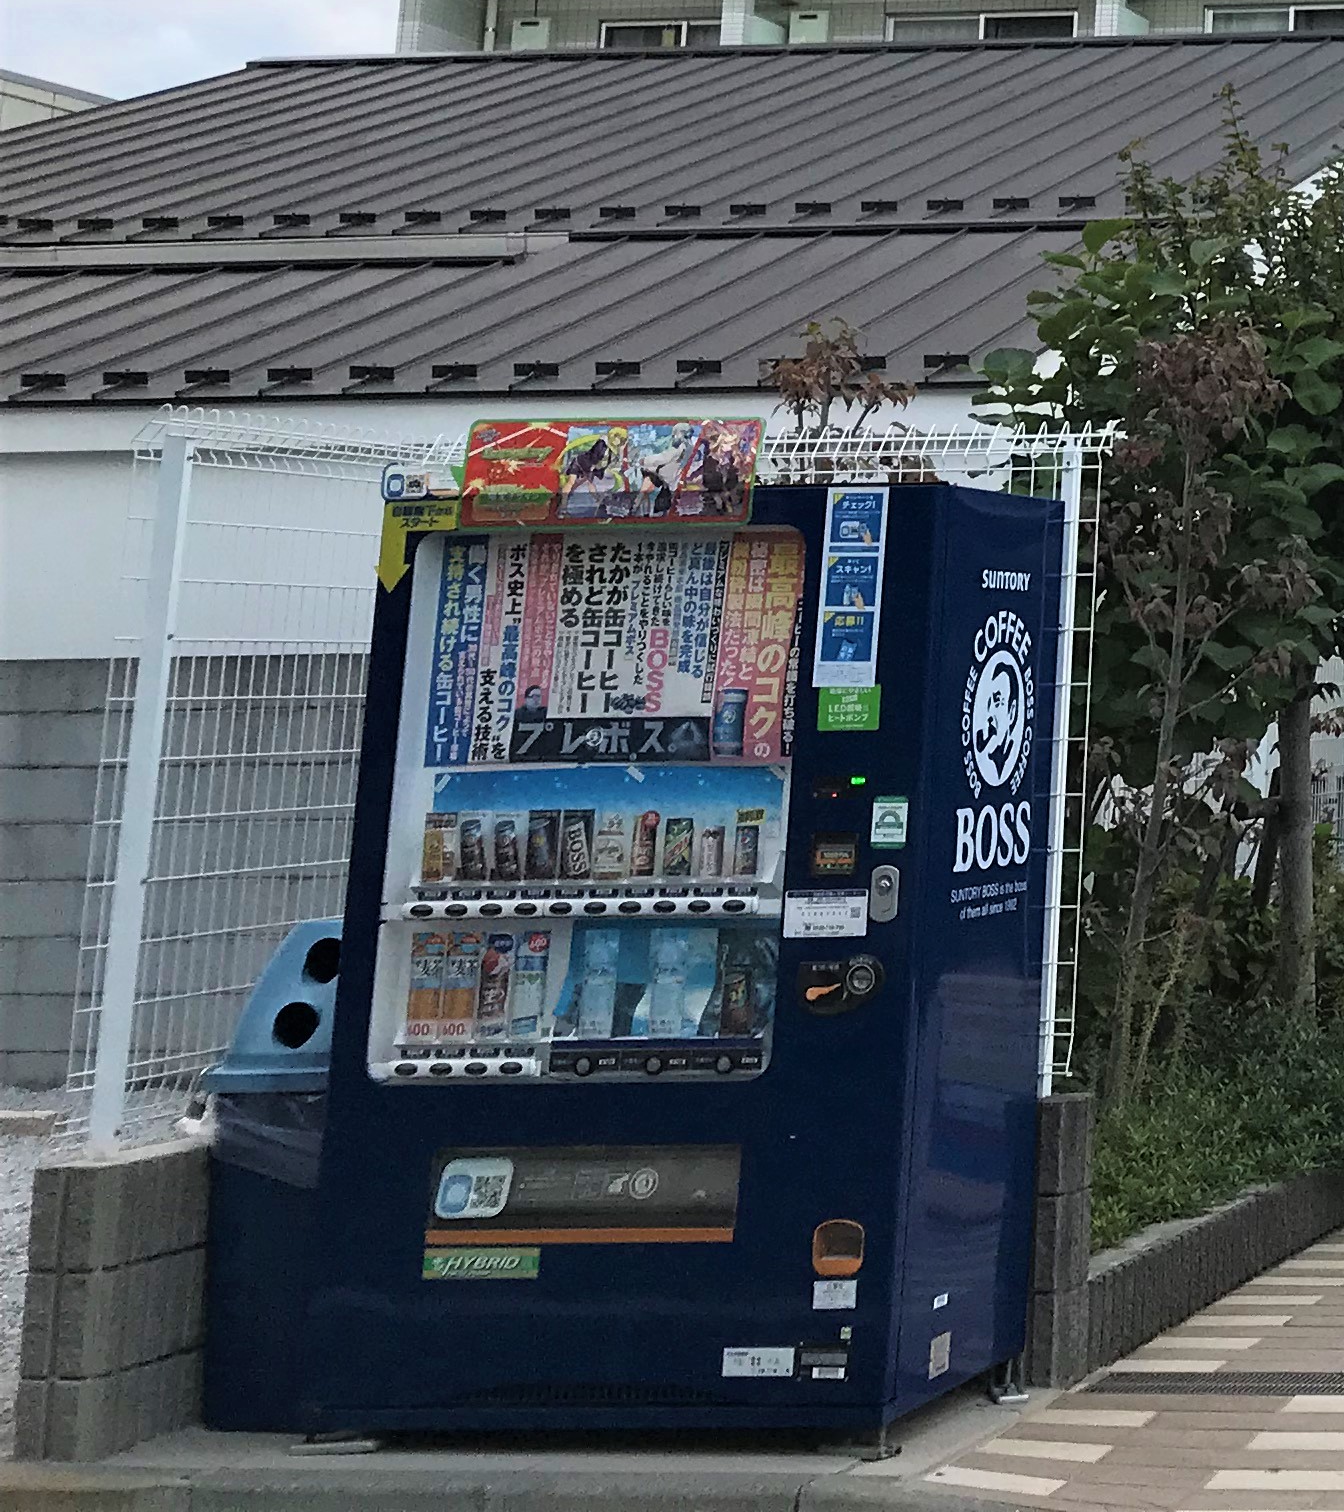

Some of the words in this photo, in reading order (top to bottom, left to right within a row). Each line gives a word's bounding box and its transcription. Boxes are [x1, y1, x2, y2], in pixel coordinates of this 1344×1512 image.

[399, 517, 439, 528] スタート
[982, 569, 1031, 591] SUNTORY
[974, 610, 1032, 666] COFFEE
[961, 665, 979, 747] COFFEE
[1023, 666, 1035, 720] BOSS
[964, 750, 982, 800] BOSS
[1009, 726, 1033, 796] COFFEE
[568, 826, 589, 874] BOSS
[952, 800, 1031, 872] BOSS
[951, 885, 982, 903] SUNTORY
[981, 882, 1000, 899] BOSS
[442, 1256, 520, 1276] HYBRID
